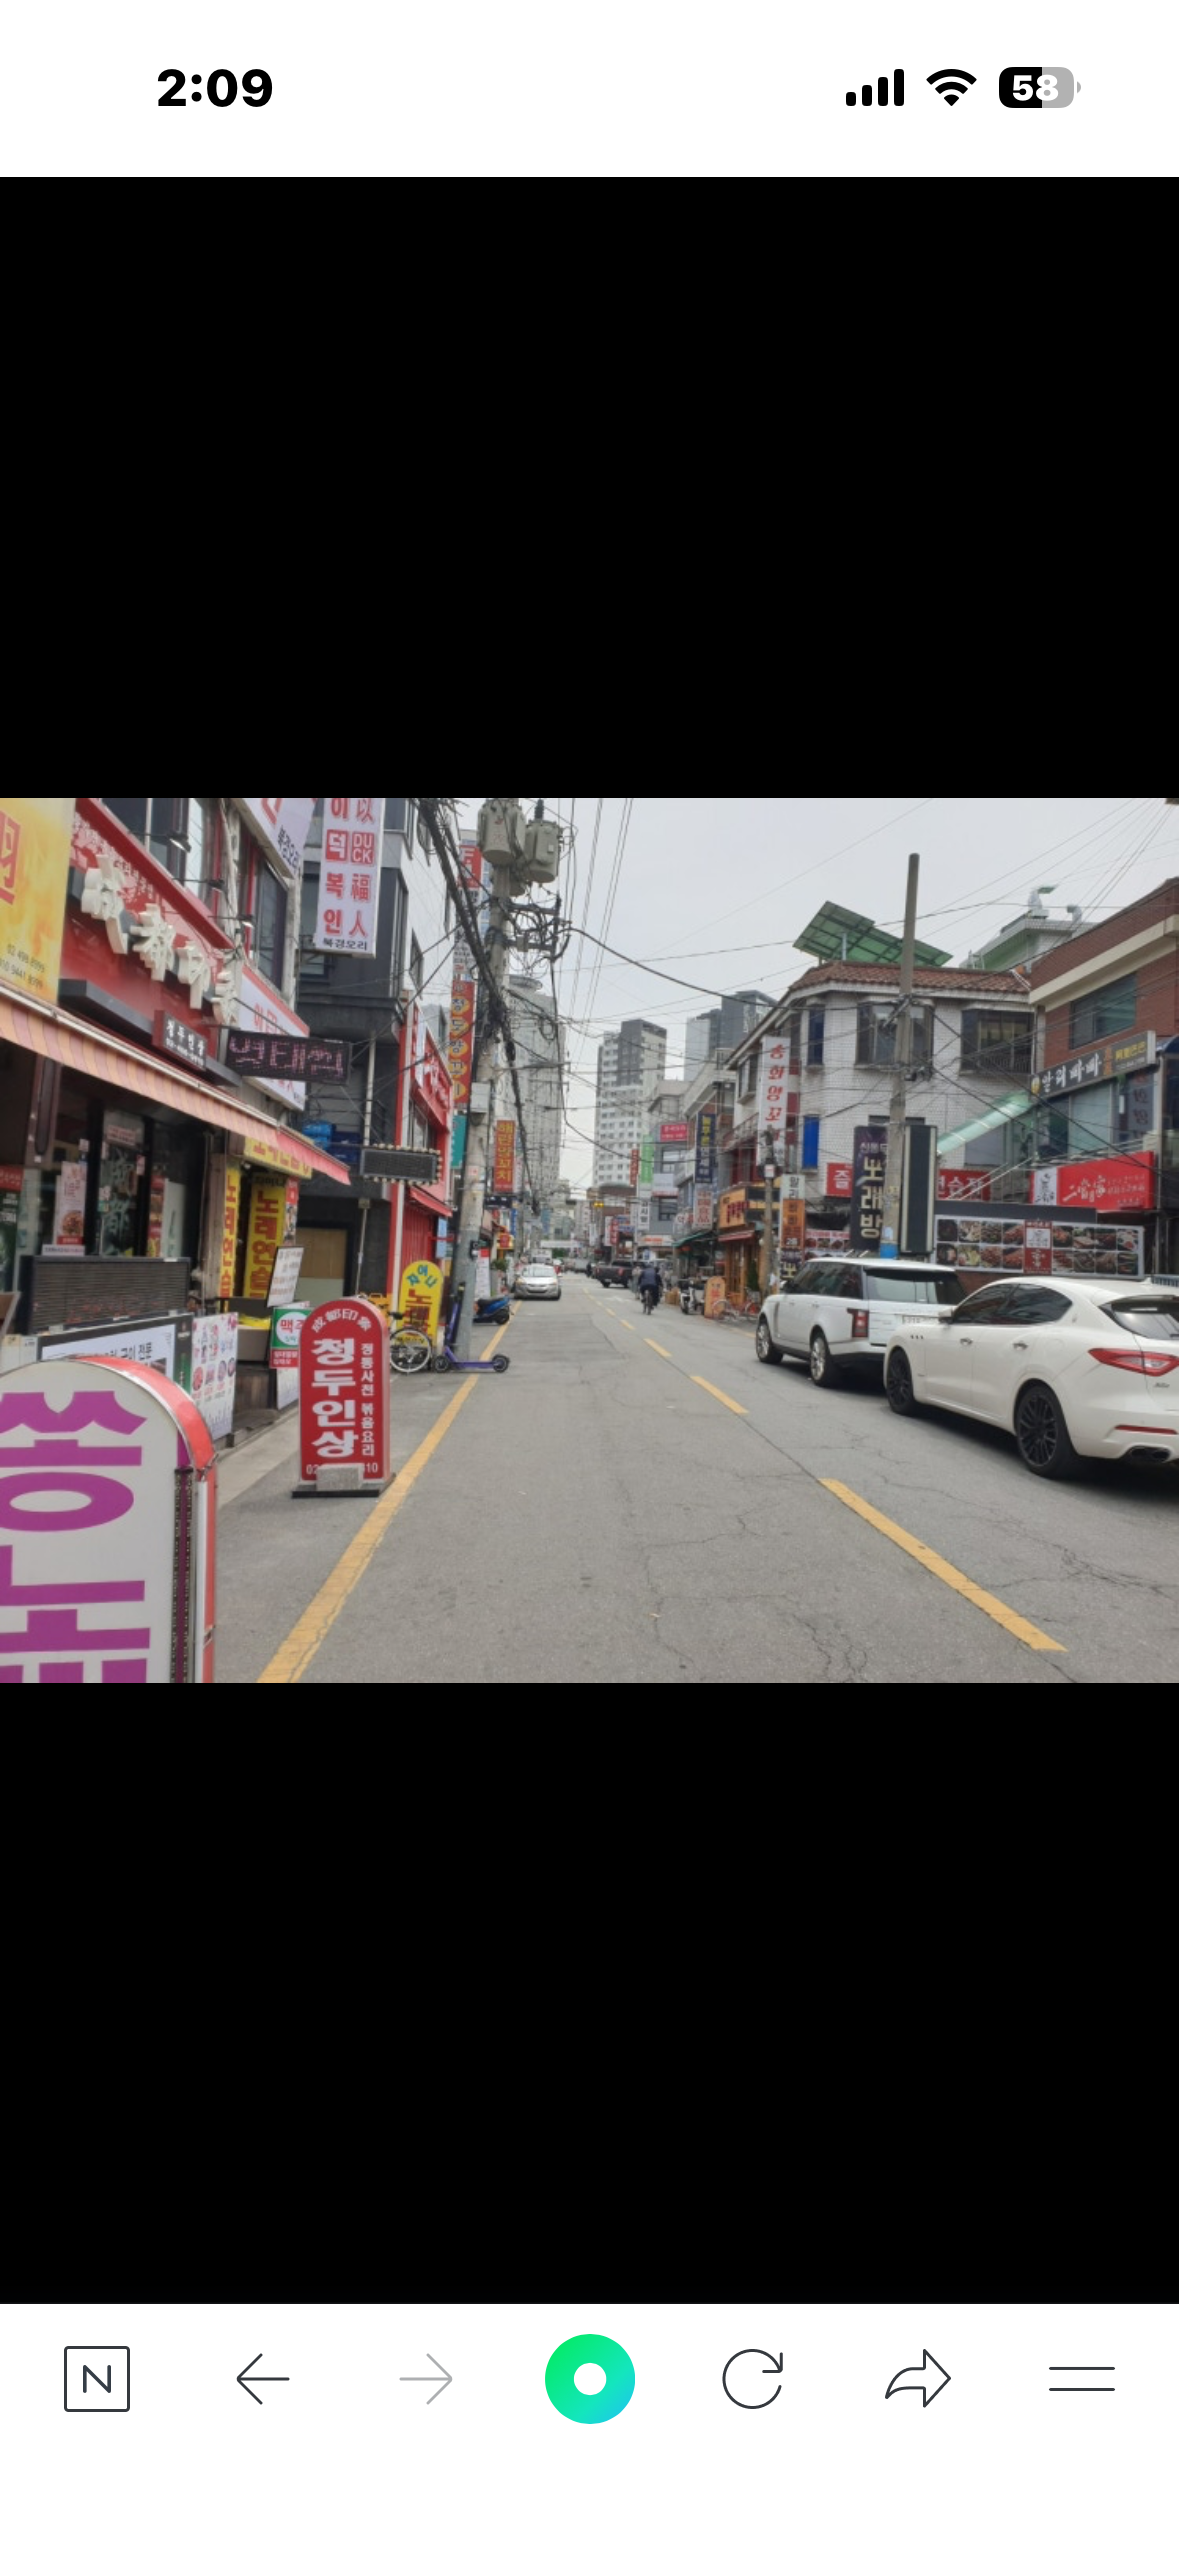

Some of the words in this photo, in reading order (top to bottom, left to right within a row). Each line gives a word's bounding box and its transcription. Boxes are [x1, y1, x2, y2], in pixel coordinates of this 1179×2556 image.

[323, 937, 368, 951] 북경오리
[860, 1156, 884, 1239] 노래방
[311, 1337, 358, 1458] 청두인상
[361, 1402, 375, 1457] 볶음요리
